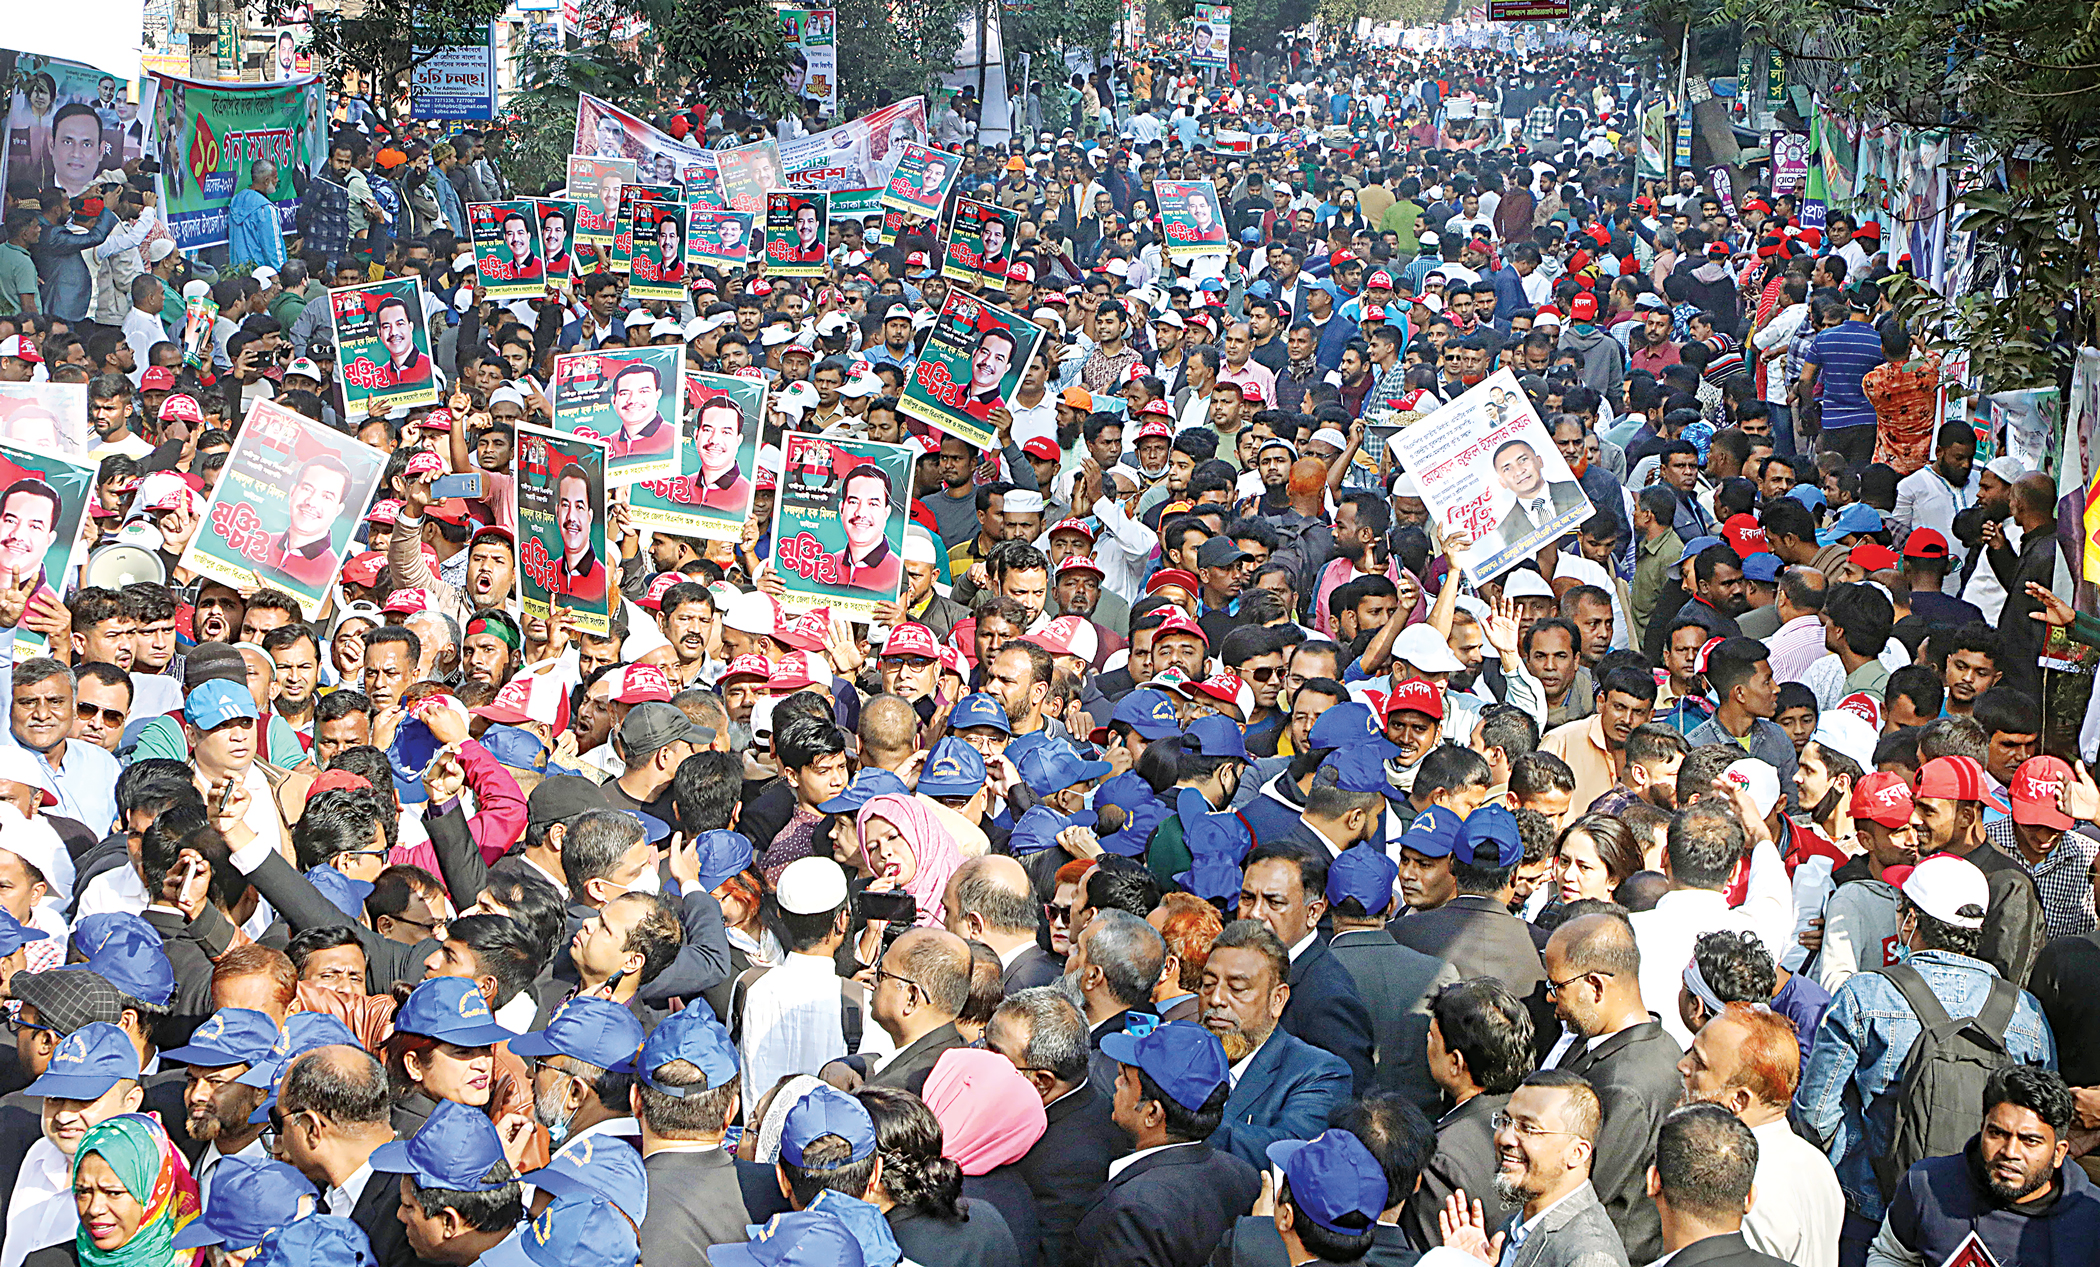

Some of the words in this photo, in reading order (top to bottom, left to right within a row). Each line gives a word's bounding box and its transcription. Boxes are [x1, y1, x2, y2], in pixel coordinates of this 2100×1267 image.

[418, 68, 442, 84] ভর্তি
[445, 73, 485, 87] চলছে!
[806, 83, 832, 98] সমাবেশ
[195, 131, 218, 177] ১০
[223, 125, 243, 175] গন
[890, 178, 911, 191] মুক্তি
[897, 187, 916, 199] চাই
[1804, 204, 1823, 220] প্রচ
[1165, 221, 1186, 237] মুক্তি
[1177, 228, 1197, 241] চাই
[689, 240, 709, 251] মুক্তি
[698, 246, 716, 256] চাই
[767, 238, 788, 257] মুক্তি
[778, 247, 796, 262] চাই
[949, 242, 971, 259] মুক্তি
[478, 253, 501, 275] মুক্তি
[491, 263, 513, 280] চাই
[631, 252, 650, 274] মুক্তি
[958, 253, 977, 268] চাই
[641, 263, 657, 281] চাই
[928, 337, 948, 352] ফজলুল
[945, 344, 957, 356] হক
[955, 346, 971, 361] মিলন
[343, 356, 374, 386] মুক্তি
[361, 367, 389, 389] চাই
[915, 360, 951, 387] মুক্তি
[926, 379, 957, 406] চাই
[902, 396, 919, 410] গাজীপুর
[917, 404, 929, 414] জেলা
[928, 408, 945, 421] বিএনপি
[955, 421, 973, 435] সহযোগী
[971, 429, 987, 441] সংগঠন
[1419, 457, 1457, 488] মোহাম্মদ
[1453, 442, 1483, 469] নূরুল
[1476, 423, 1511, 453] ইসলাম
[1506, 412, 1533, 435] নয়ন
[654, 475, 690, 503] চাই
[782, 505, 806, 519] ফজলুল
[806, 508, 818, 520] হক
[819, 506, 837, 521] মিলন
[1442, 484, 1495, 525] নিঃশর্ত
[210, 501, 261, 539] মুক্তি
[630, 508, 650, 520] গাজীপুর
[650, 512, 664, 521] জেলা
[664, 513, 684, 524] বিএনপি
[699, 518, 720, 529] সহযোগী
[720, 521, 738, 532] সংগঠন
[1458, 500, 1496, 533] মুক্তি
[1467, 515, 1499, 542] চাই
[226, 527, 270, 564] চাই
[777, 531, 823, 571] মুক্তি
[520, 536, 547, 578] মুক্তি
[535, 560, 559, 593] চাই
[799, 553, 838, 584] চাই
[796, 595, 810, 604] জেলা
[811, 595, 832, 607] বিএনপি
[833, 599, 842, 608] অঙ্গ
[849, 600, 871, 612] সহযোগী
[1398, 681, 1432, 699] যুবদল
[2027, 777, 2061, 799] যুবদ
